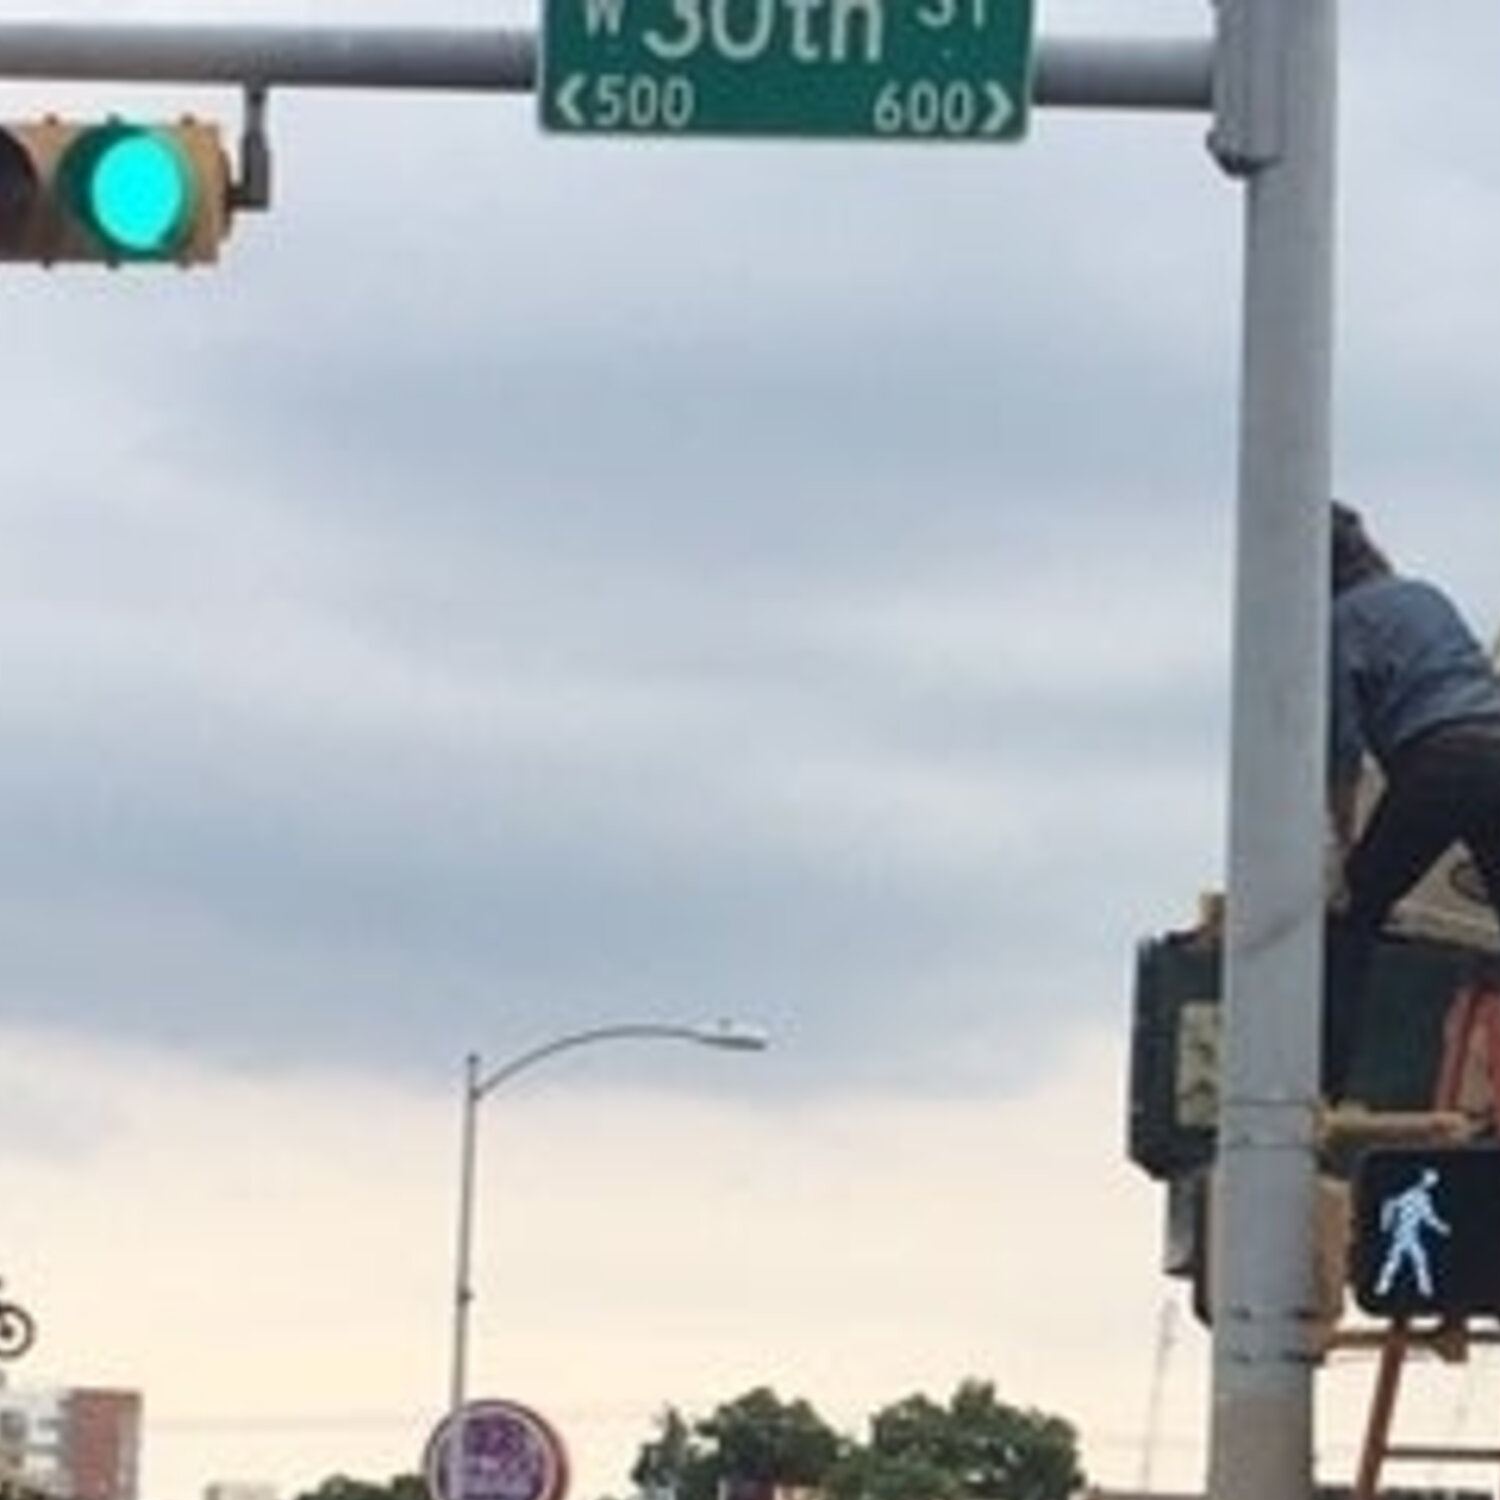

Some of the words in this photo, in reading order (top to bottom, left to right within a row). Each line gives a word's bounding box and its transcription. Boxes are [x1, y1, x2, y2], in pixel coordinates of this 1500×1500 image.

[642, 0, 884, 61] 30th
[594, 73, 696, 127] 500
[872, 79, 977, 133] 600
